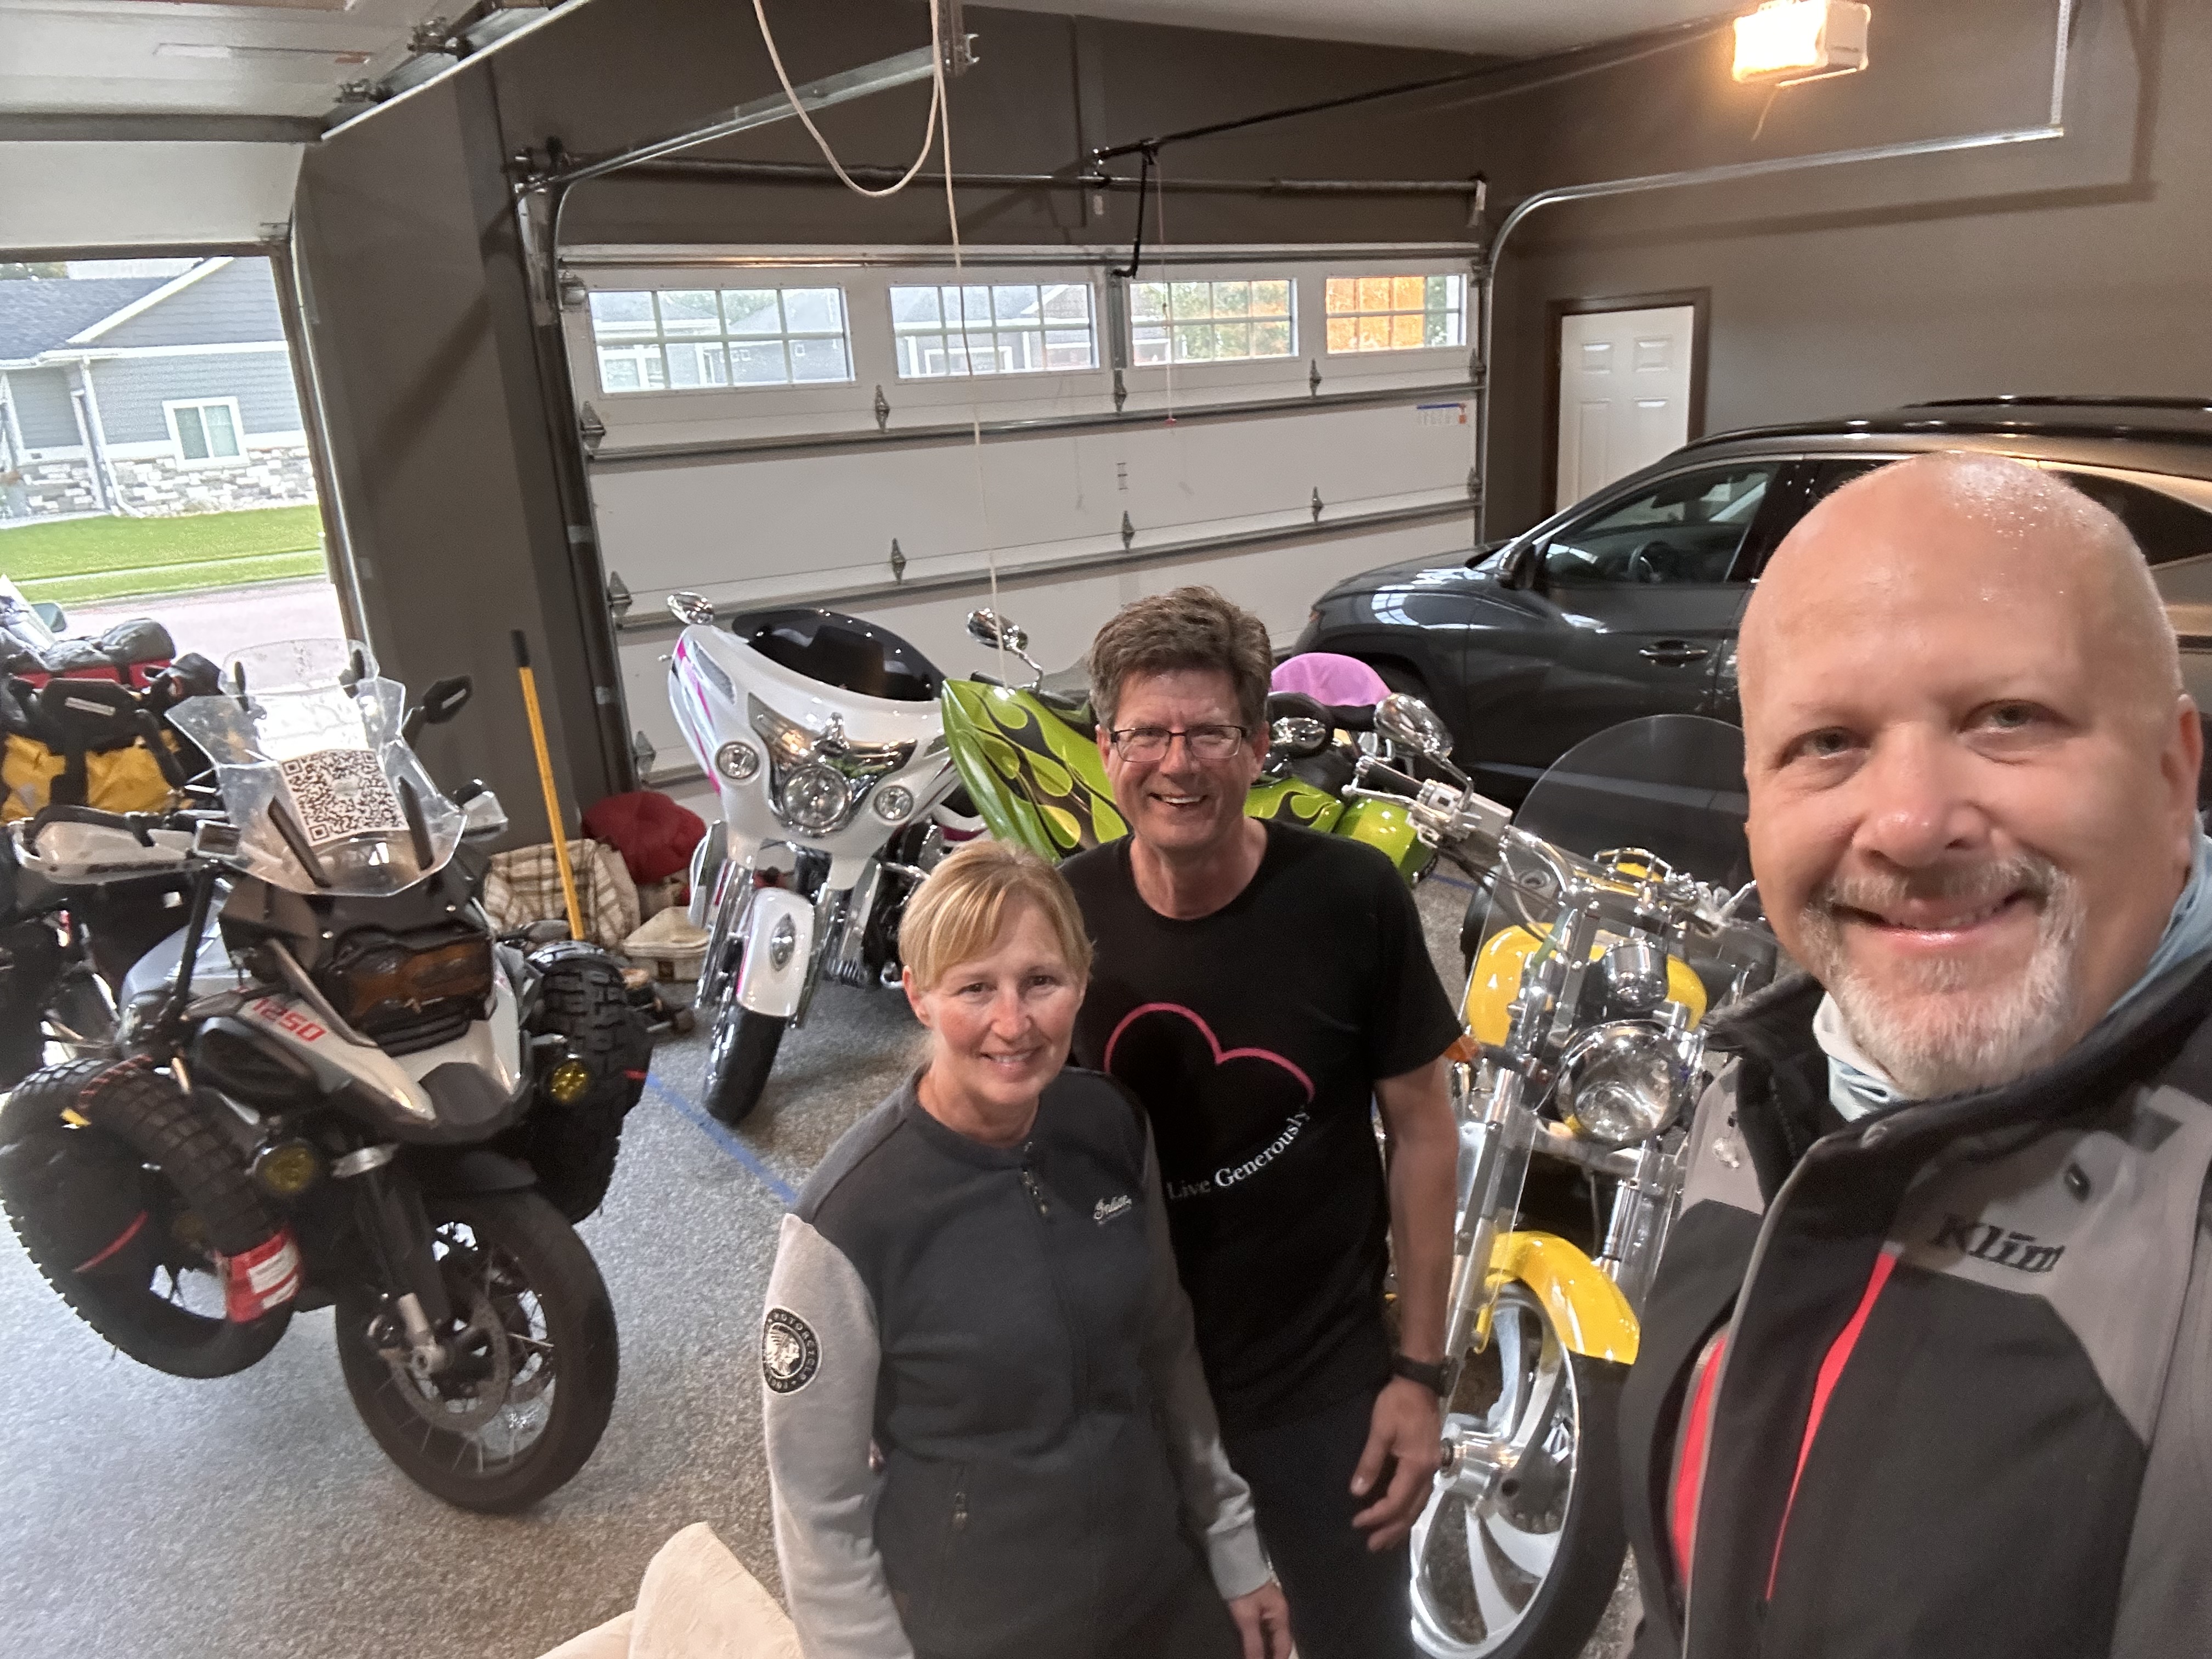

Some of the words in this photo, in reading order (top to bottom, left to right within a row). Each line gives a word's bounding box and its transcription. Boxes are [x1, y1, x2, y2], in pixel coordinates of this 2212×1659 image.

[253, 997, 328, 1041] 1250
[1166, 1180, 1211, 1199] Live
[1214, 1107, 1311, 1187] Generously
